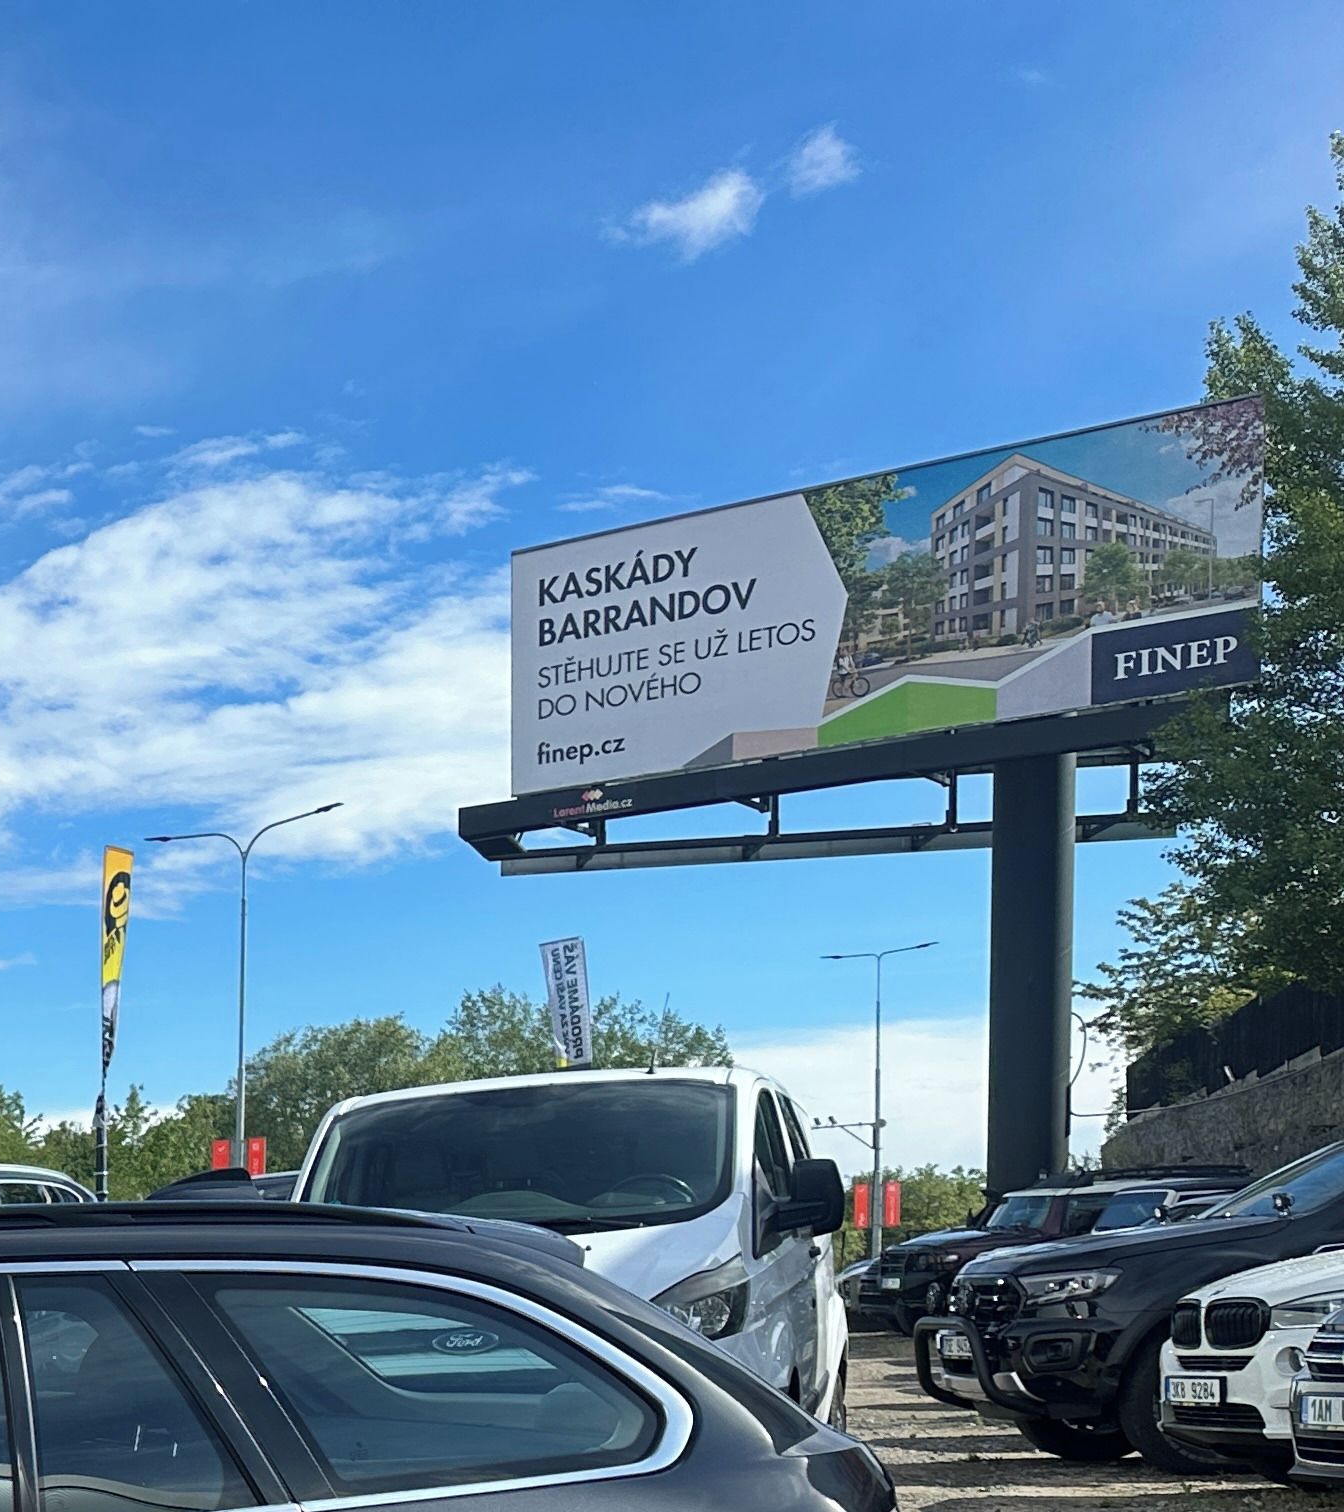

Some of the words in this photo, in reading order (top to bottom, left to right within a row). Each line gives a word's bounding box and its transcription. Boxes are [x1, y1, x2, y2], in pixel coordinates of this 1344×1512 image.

[538, 546, 698, 607] KASKÁDY
[538, 578, 757, 647] BARRANDOV
[537, 648, 650, 688] STĚHUJTE
[658, 641, 686, 667] SE
[694, 628, 729, 660] UŽ
[737, 618, 817, 653] LETOS
[1113, 635, 1239, 680] FINEP
[538, 694, 577, 720] DO
[585, 672, 702, 712] NOVÉHO
[537, 737, 625, 765] finep.cz
[446, 1333, 484, 1347] Ford
[1311, 1399, 1332, 1422] 1AM
